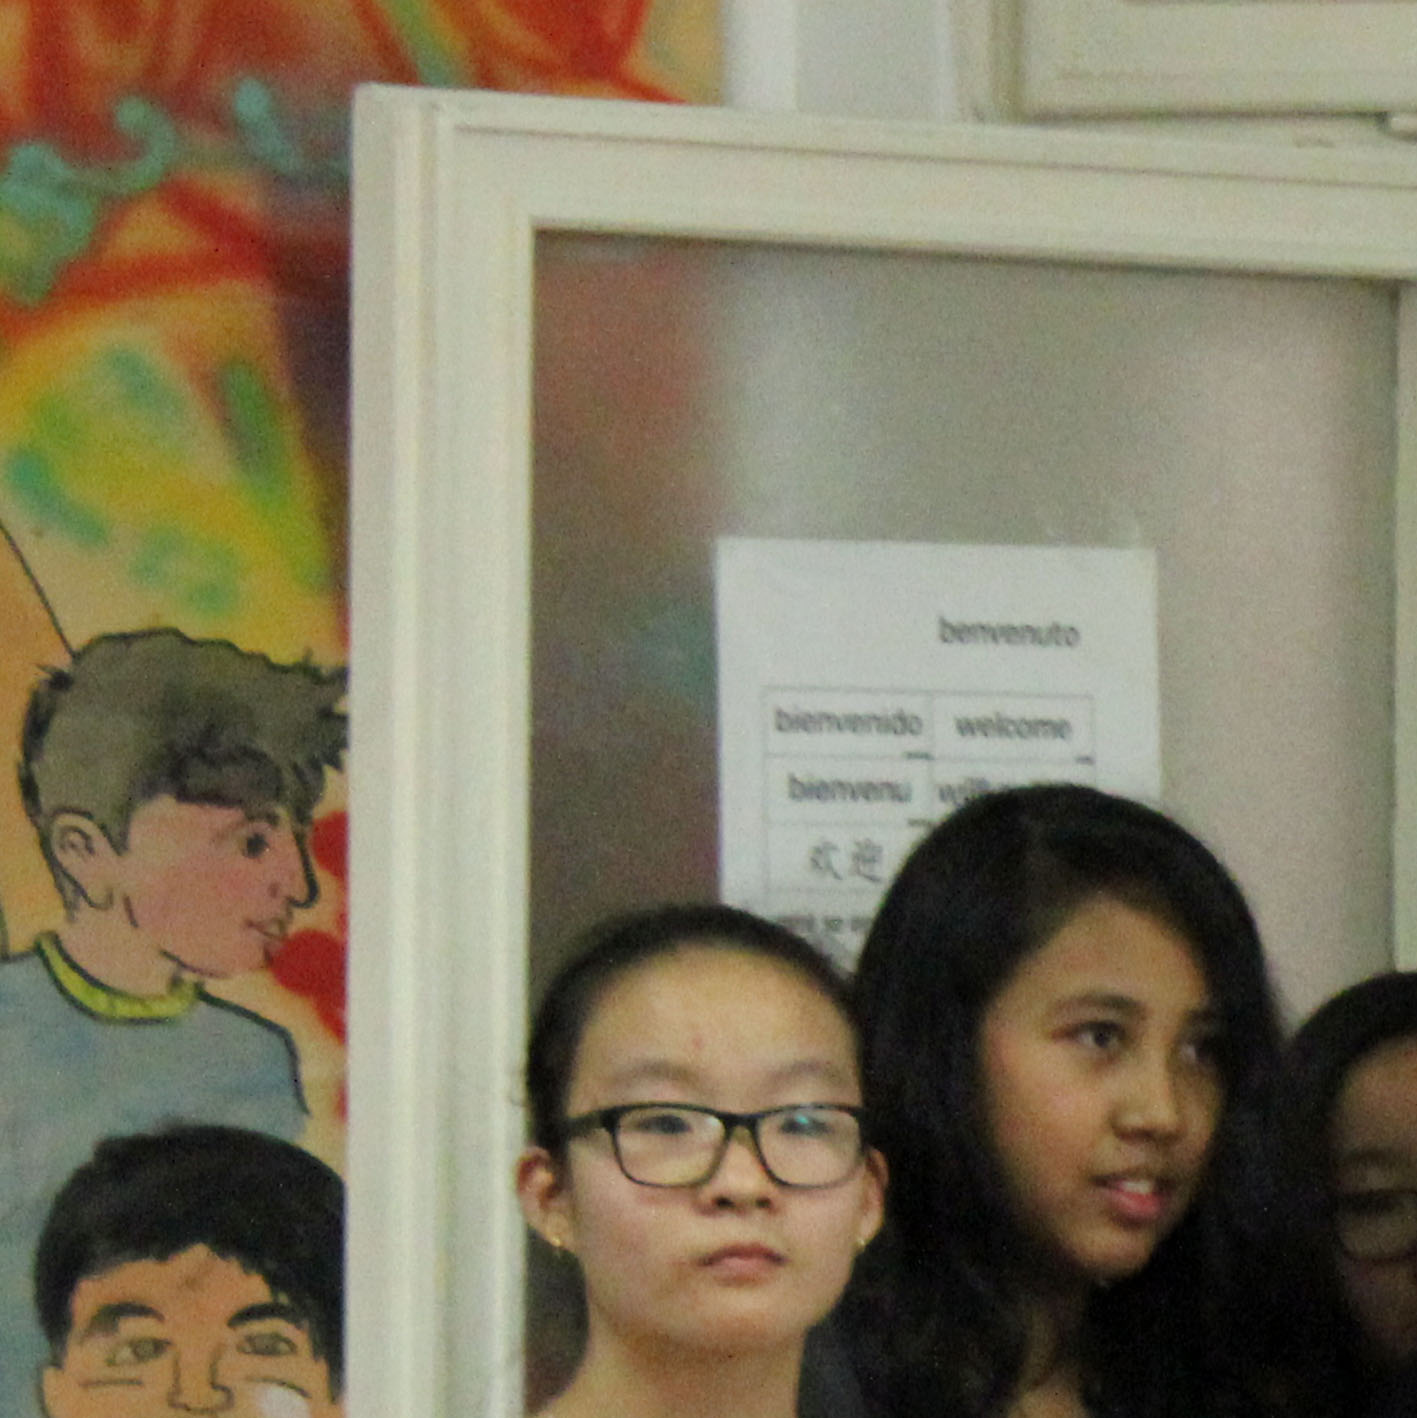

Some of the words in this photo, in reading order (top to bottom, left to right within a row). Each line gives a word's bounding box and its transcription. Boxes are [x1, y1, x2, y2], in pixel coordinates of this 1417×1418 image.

[938, 616, 1080, 648] benvenuto
[774, 708, 924, 737] bienvenido
[955, 711, 1072, 740] welcome
